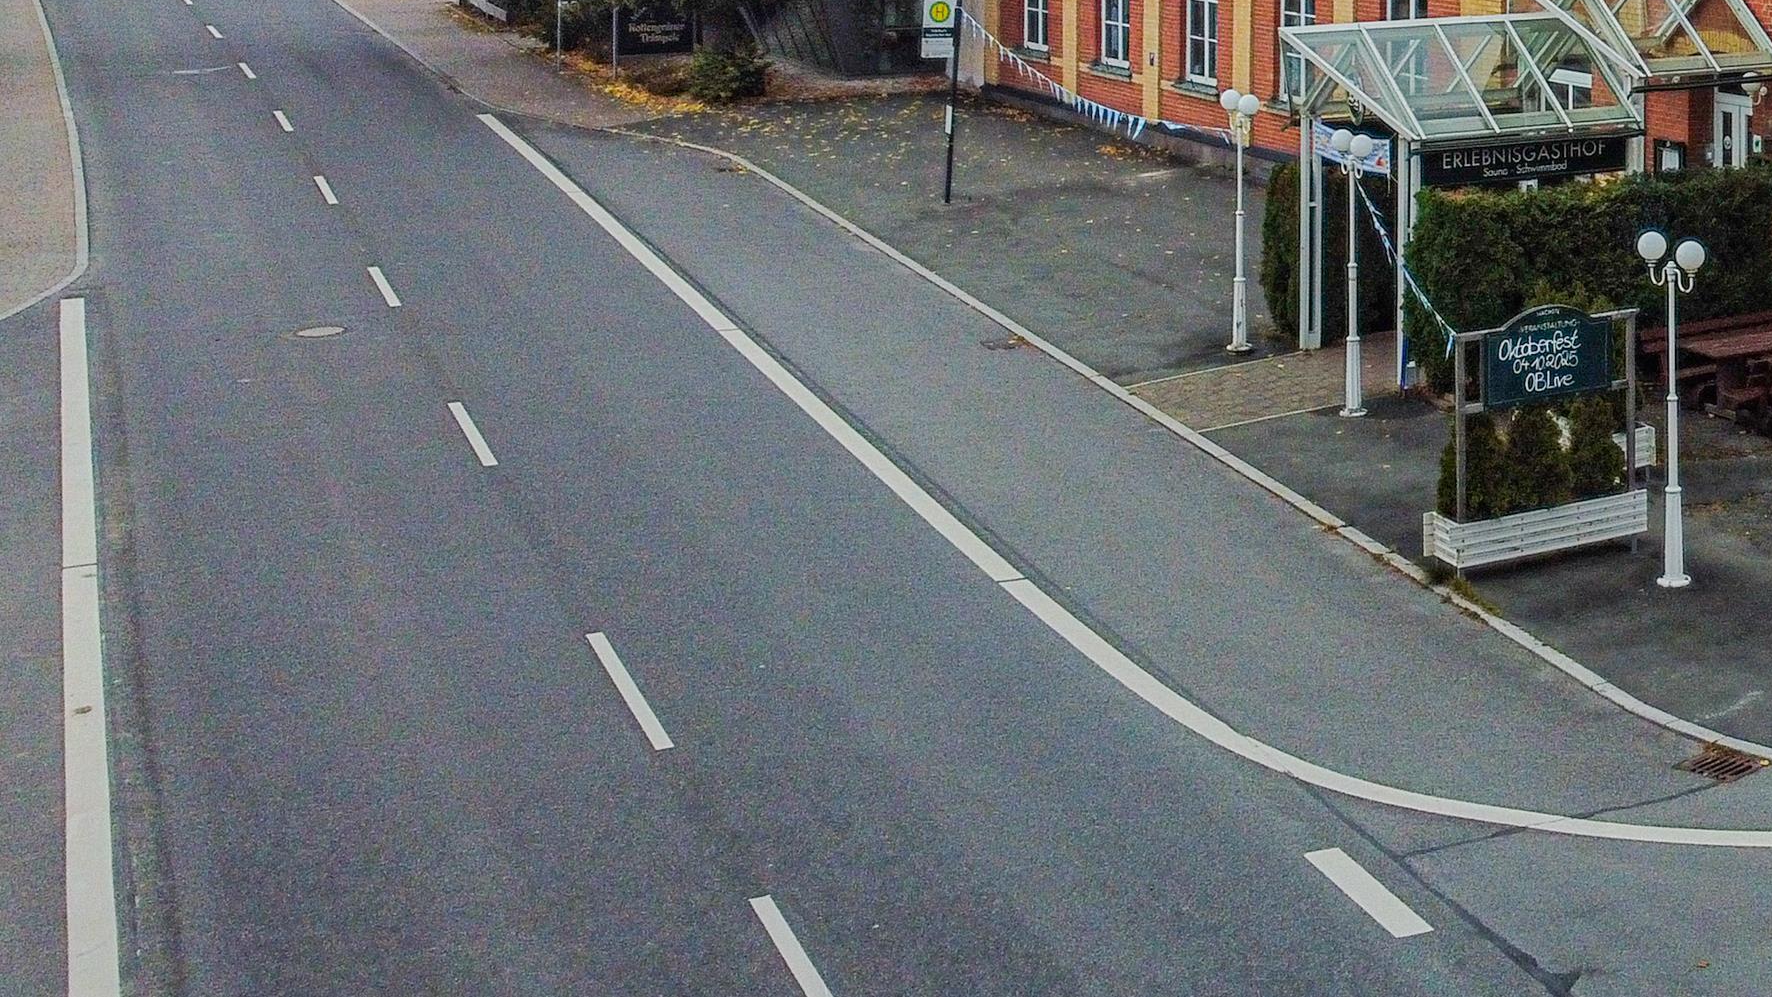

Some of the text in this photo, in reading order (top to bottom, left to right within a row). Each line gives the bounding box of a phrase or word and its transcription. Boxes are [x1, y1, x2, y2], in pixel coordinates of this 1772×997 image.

[1442, 139, 1606, 170] ERLEBNISGASTHOF
[1483, 167, 1508, 178] Sauna
[1516, 160, 1567, 175] Schwimmbad
[1499, 329, 1582, 362] Oktoberfest
